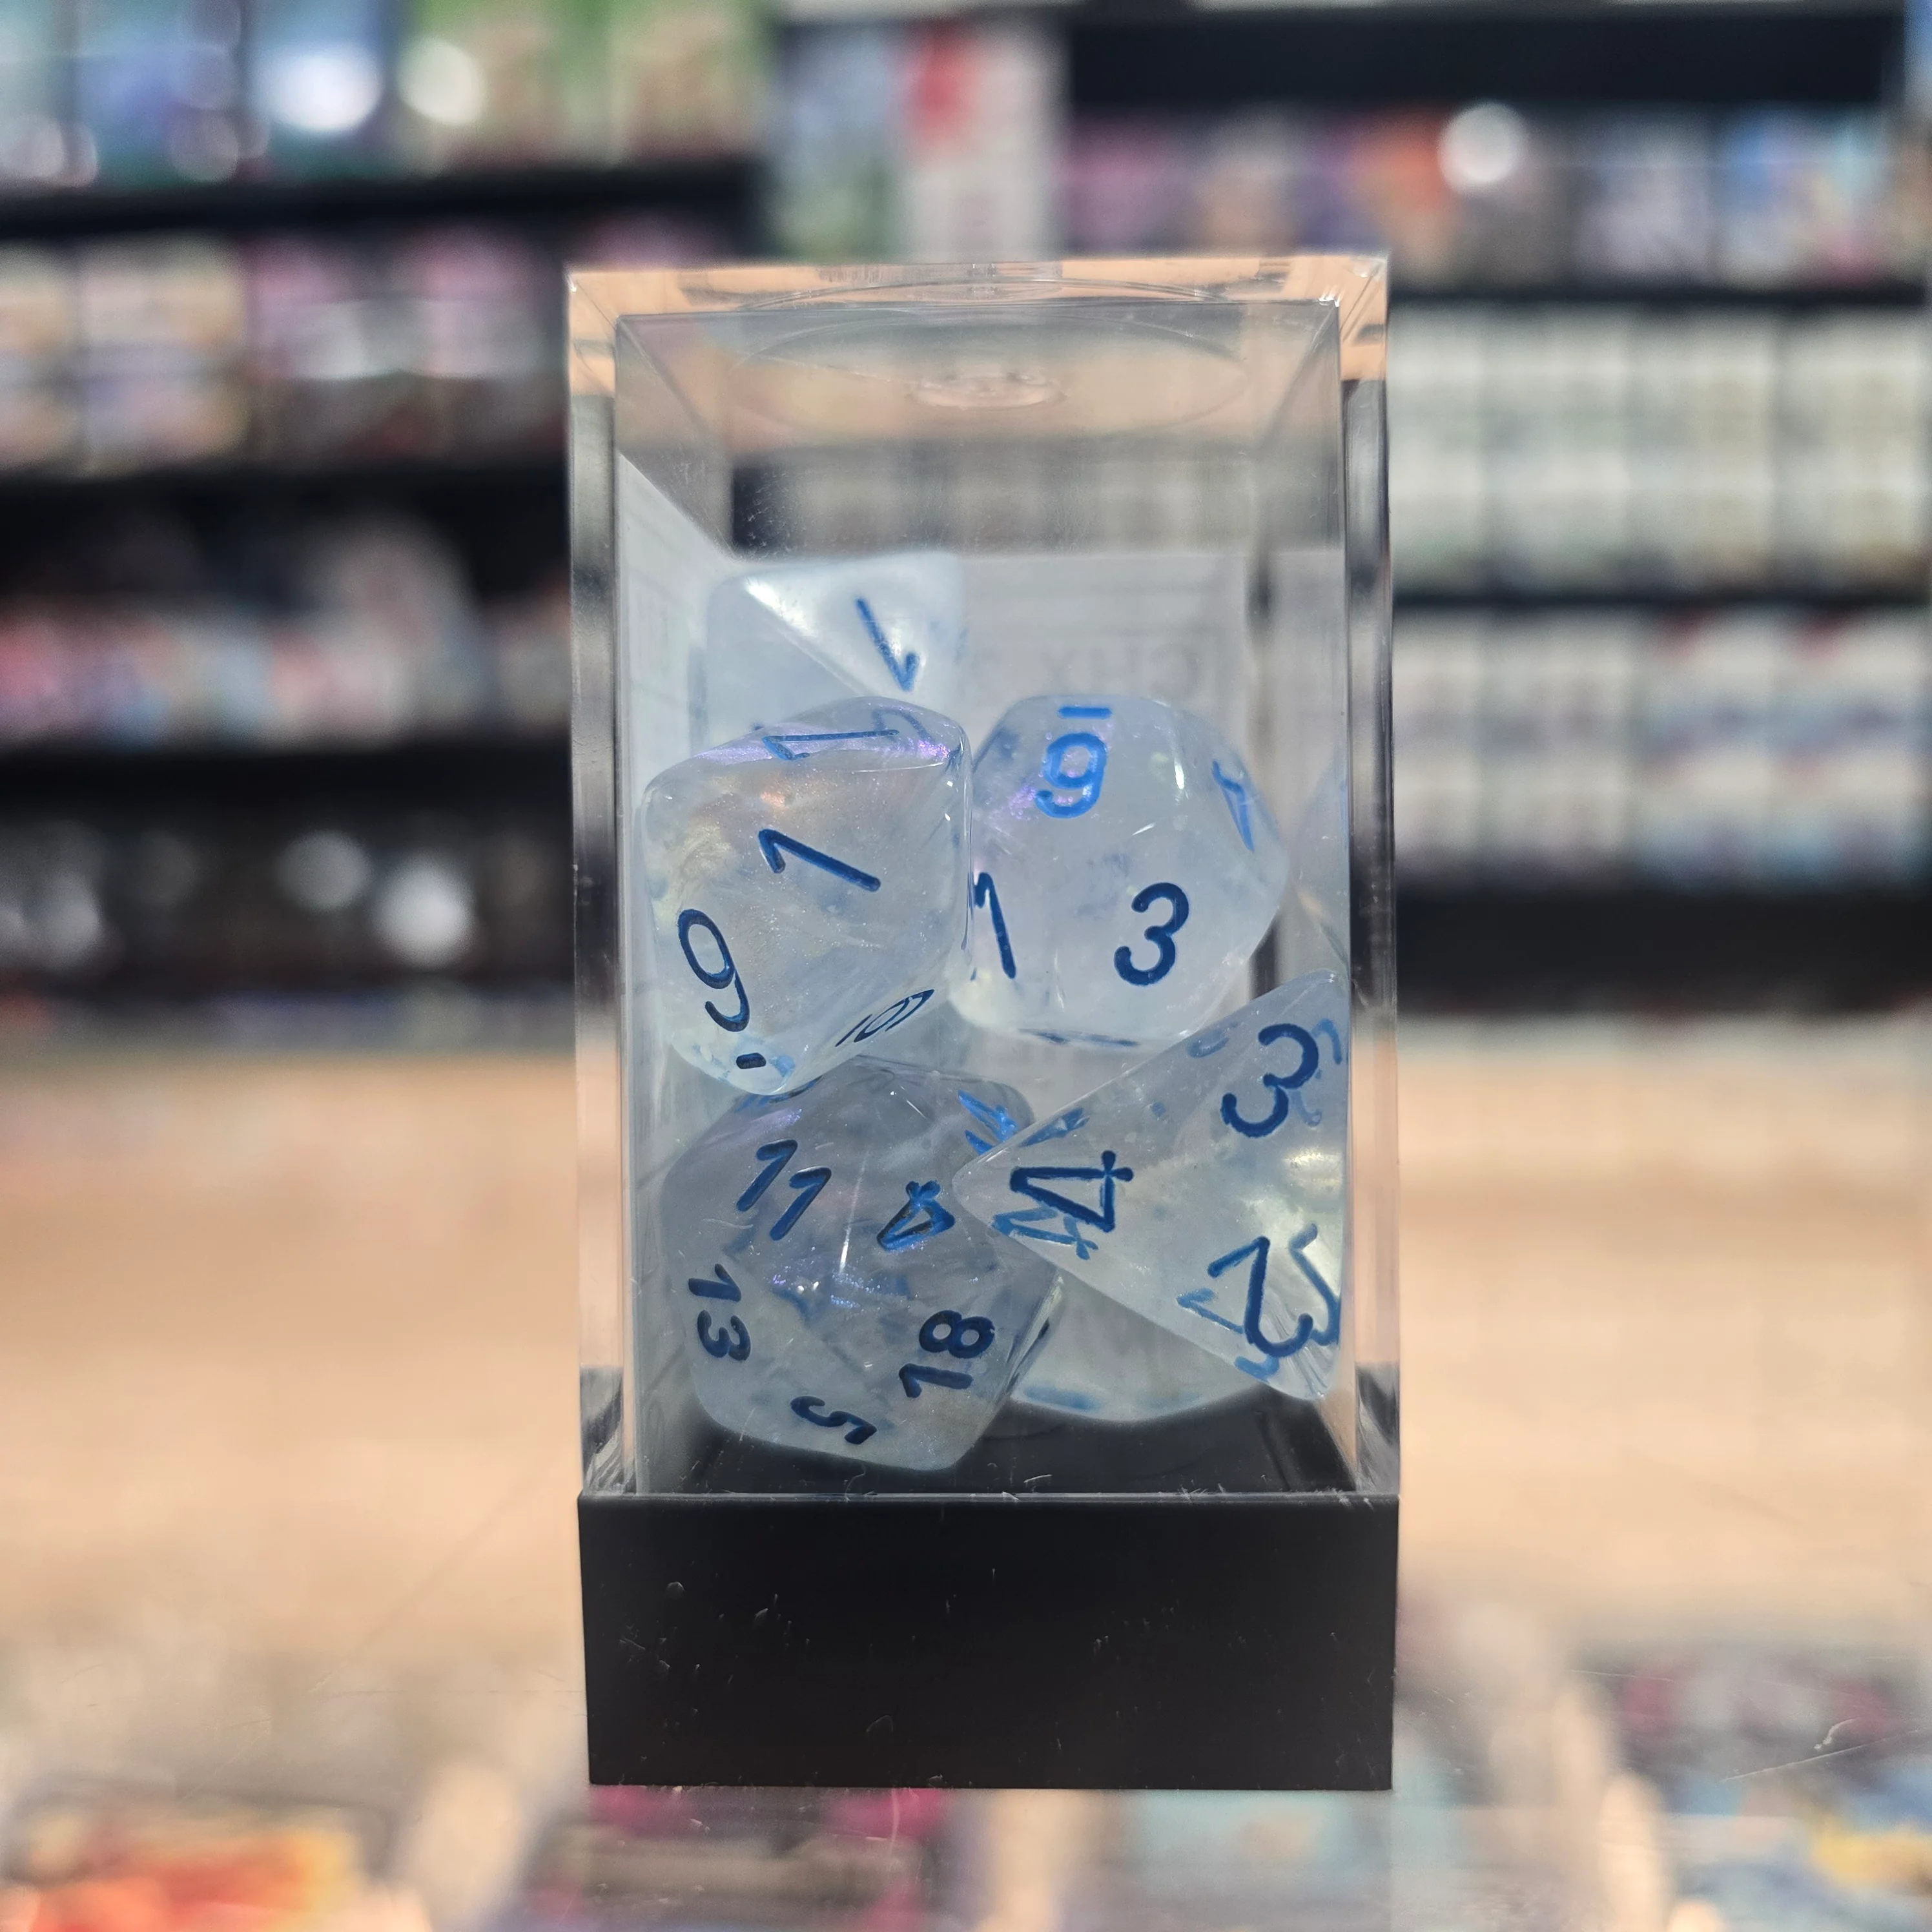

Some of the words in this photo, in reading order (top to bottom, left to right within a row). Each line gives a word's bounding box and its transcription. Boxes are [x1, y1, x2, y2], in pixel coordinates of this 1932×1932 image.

[1113, 882, 1189, 985] 3
[1220, 1023, 1320, 1138] 3
[736, 1138, 832, 1241] 11
[877, 1179, 956, 1251] 4
[1009, 1150, 1134, 1233] 4
[688, 1263, 751, 1361] 13
[898, 1310, 996, 1399] 18
[790, 1395, 878, 1445] 5
